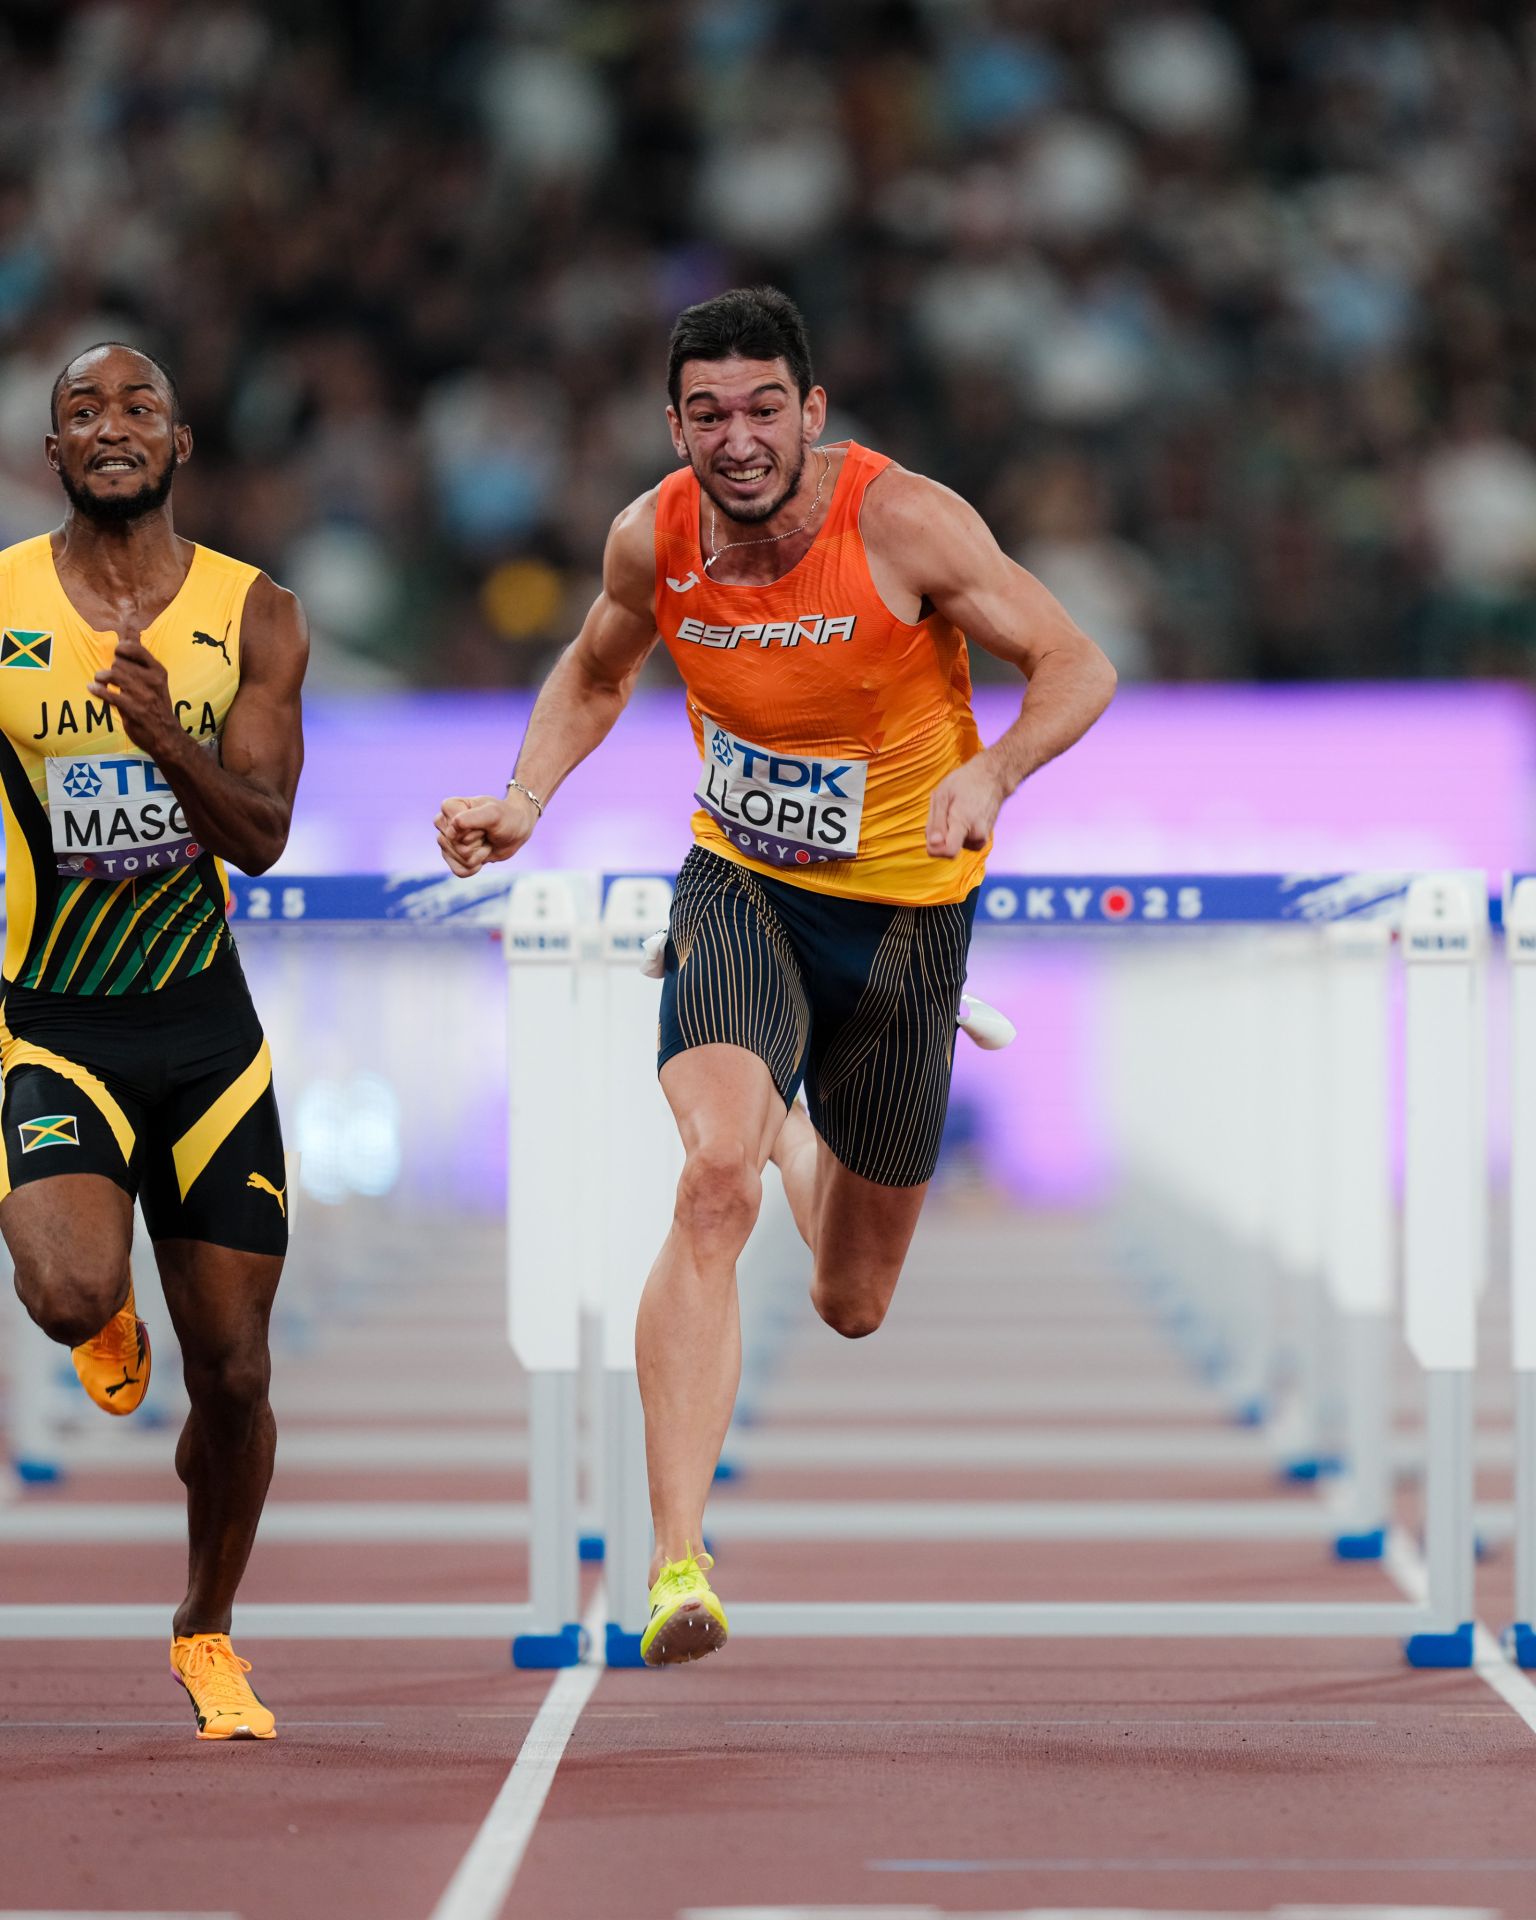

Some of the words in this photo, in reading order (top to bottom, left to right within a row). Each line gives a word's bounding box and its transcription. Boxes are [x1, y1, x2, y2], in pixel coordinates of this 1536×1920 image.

[676, 614, 856, 649] ESPAÑA
[33, 700, 217, 740] JAMCA
[100, 760, 173, 796] TD
[733, 741, 853, 799] TDK
[706, 764, 848, 845] LLOPIS
[64, 803, 191, 847] MASO
[985, 886, 1134, 920] OKYO
